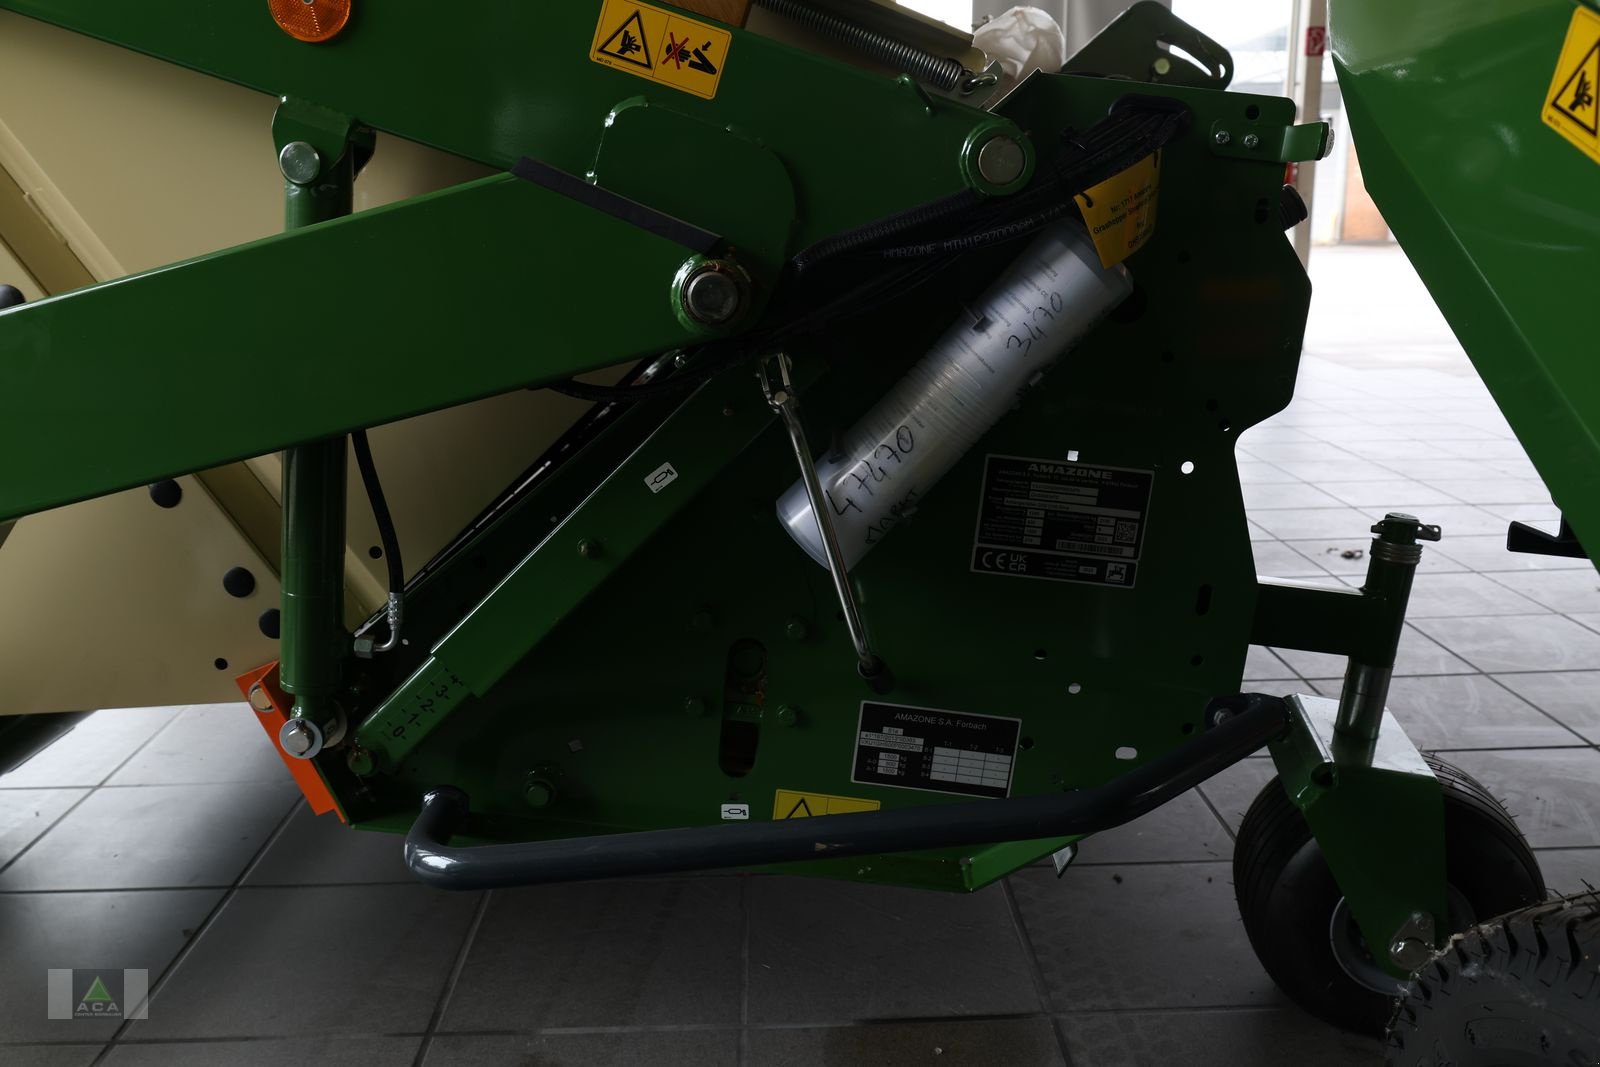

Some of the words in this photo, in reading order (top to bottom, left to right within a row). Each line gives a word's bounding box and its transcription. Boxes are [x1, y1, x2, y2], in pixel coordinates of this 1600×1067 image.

[883, 242, 937, 258] AMAZONE
[1006, 291, 1063, 357] 3470
[825, 425, 914, 516] 47470
[1027, 463, 1113, 480] AMAZONE
[435, 685, 449, 697] 3
[420, 698, 434, 711] 2
[407, 713, 419, 724] 1
[894, 712, 938, 725] AMAZONE
[938, 717, 954, 727] S.A.
[956, 719, 988, 731] Forbach
[393, 726, 405, 737] 0
